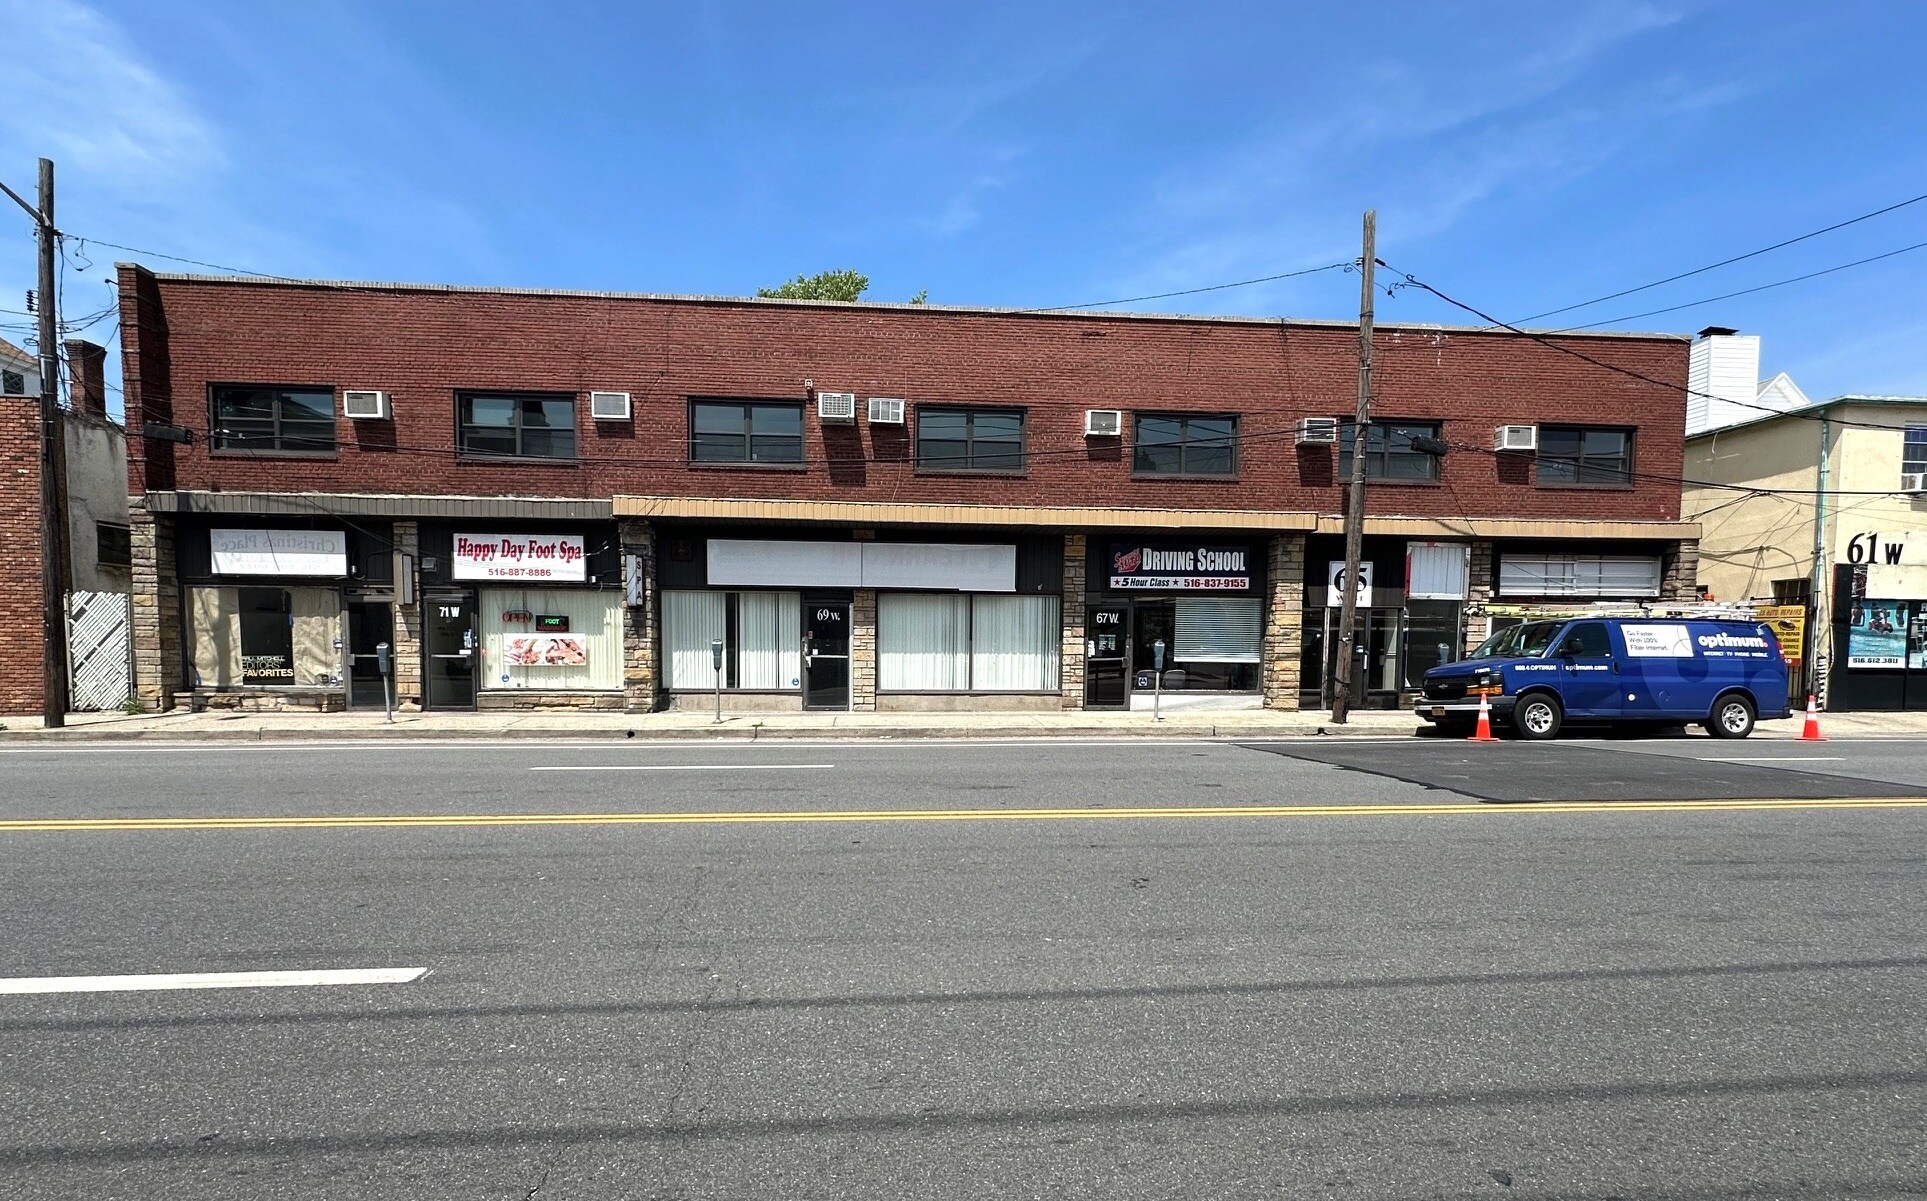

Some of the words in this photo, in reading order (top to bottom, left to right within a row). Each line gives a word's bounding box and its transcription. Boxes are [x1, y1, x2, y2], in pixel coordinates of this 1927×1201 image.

[457, 538, 498, 561] Happy
[501, 539, 526, 562] Day
[528, 540, 556, 559] Foot
[559, 541, 582, 563] Spa
[1847, 532, 1878, 564] 61
[1142, 548, 1194, 571] DRIVING
[1197, 548, 1246, 571] SCHOOL
[488, 568, 552, 577] 516-887-8886
[1121, 577, 1130, 587] 5
[1130, 578, 1148, 587] Hour
[1149, 578, 1170, 587] Class
[1184, 578, 1246, 588] 516-837-9155
[439, 606, 450, 618] 71
[450, 606, 460, 618] W
[817, 608, 830, 621] 69
[1096, 612, 1109, 624] 67
[242, 668, 294, 677] FAVORITES
